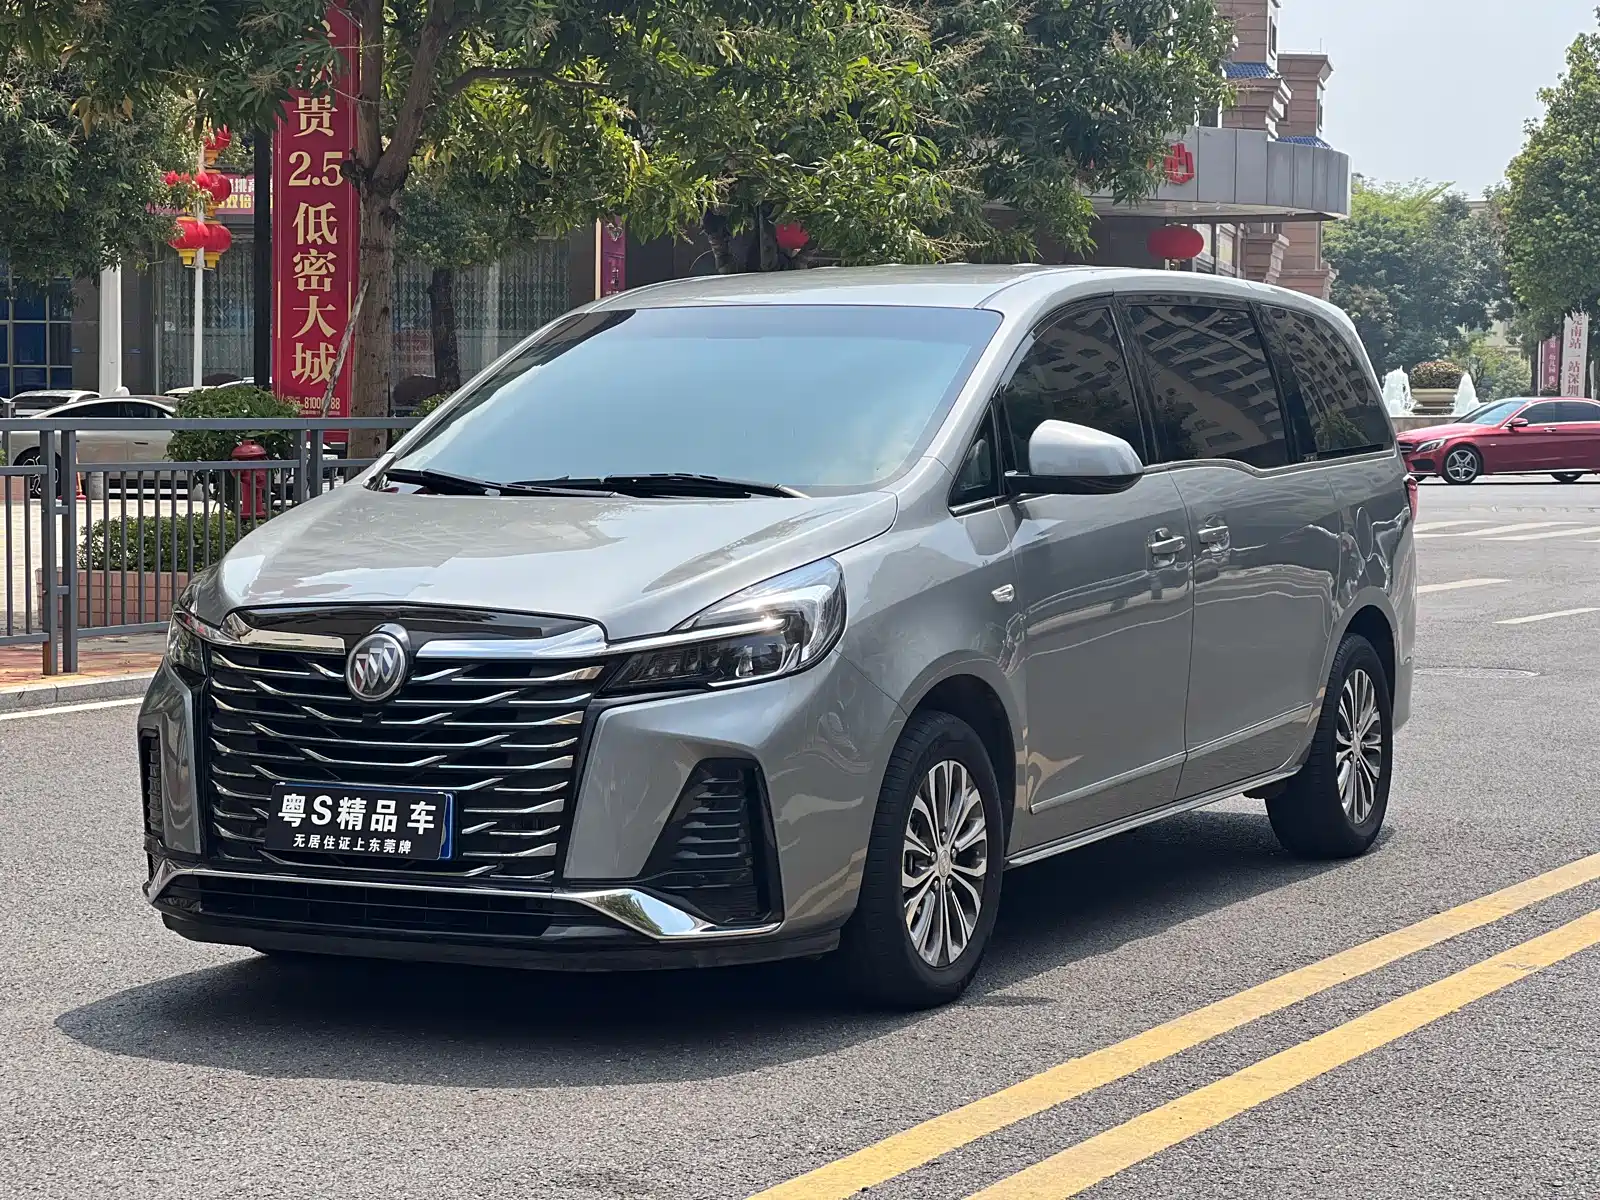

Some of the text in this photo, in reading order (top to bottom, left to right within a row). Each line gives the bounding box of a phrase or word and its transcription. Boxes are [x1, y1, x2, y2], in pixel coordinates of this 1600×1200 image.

[292, 833, 412, 854] 无居住证上东莞牌
